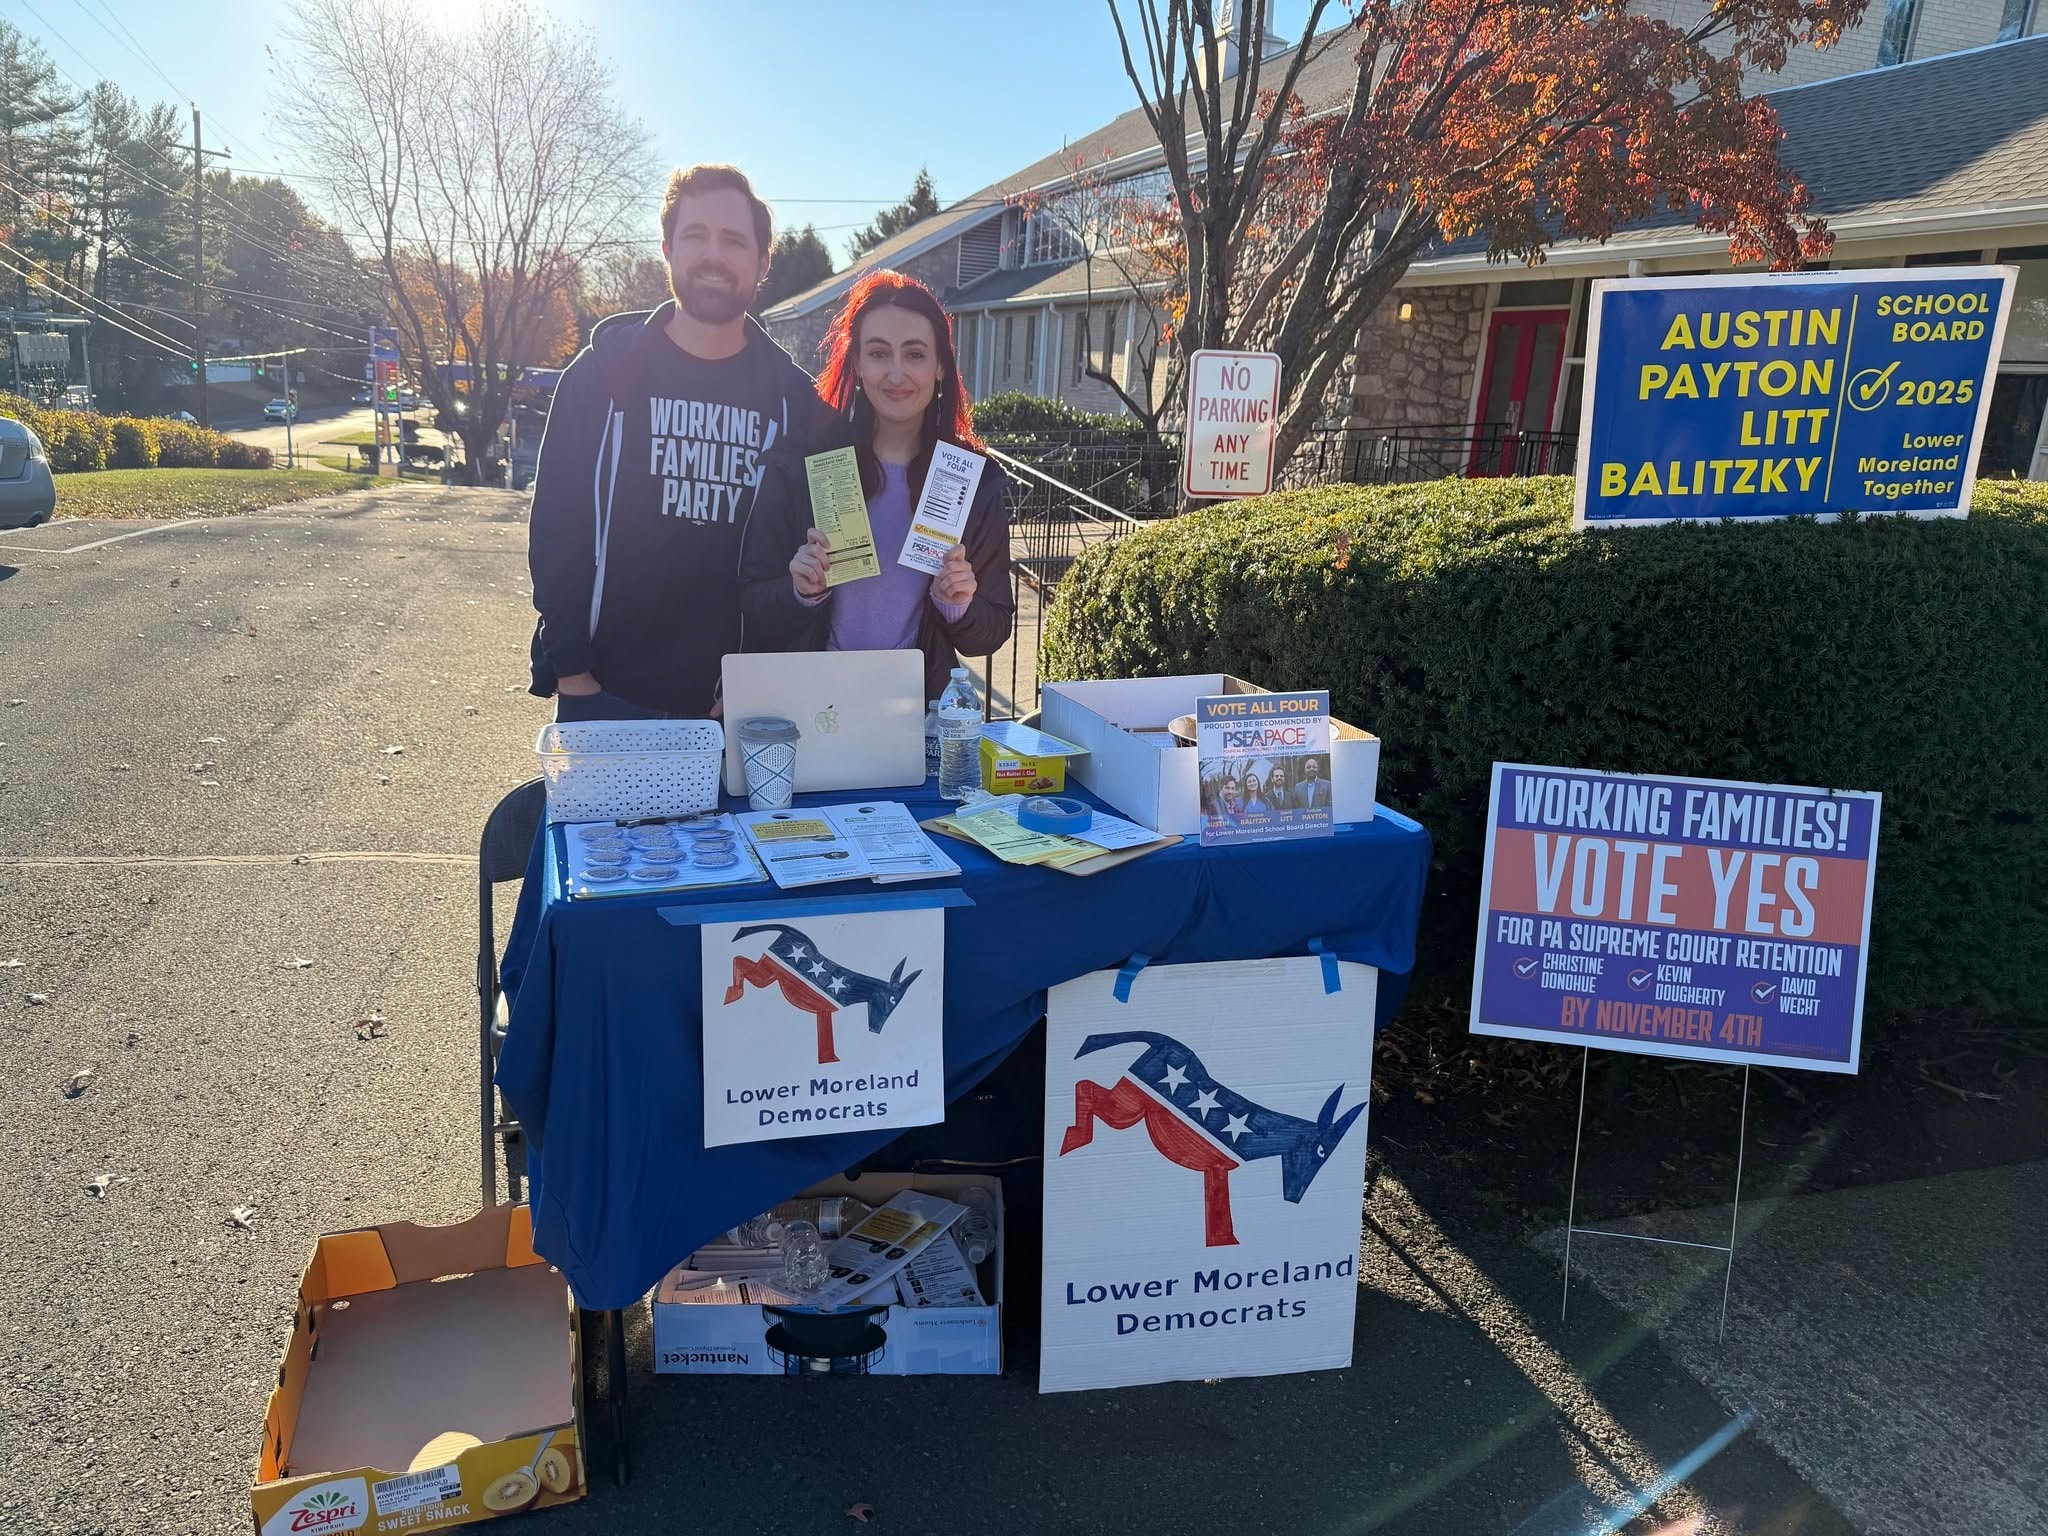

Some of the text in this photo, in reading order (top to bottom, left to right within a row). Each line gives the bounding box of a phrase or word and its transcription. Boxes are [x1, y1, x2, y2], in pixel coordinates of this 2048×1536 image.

[1876, 293, 1990, 317] SCHOOL
[1660, 308, 1842, 351] AUSTIN
[1892, 321, 1985, 343] BOARD
[1220, 365, 1251, 392] NO
[1638, 359, 1835, 401] PAYTON
[1895, 379, 1974, 406] 2025
[650, 397, 761, 449] WORKING
[1198, 397, 1269, 424] PARKING
[1740, 408, 1830, 447] LITT
[1213, 434, 1250, 454] ANY
[1902, 432, 1964, 449] Lower
[649, 437, 759, 488] FAMILIES
[942, 451, 974, 469] VOTE ALL
[946, 461, 967, 473] FOUR
[1210, 461, 1251, 481] TIME
[1857, 454, 1959, 475] Moreland
[1599, 456, 1823, 498] BALITZKY
[661, 478, 743, 524] PARTY
[1863, 479, 1955, 501] Together
[1207, 699, 1319, 717] VOTE ALL FOUR
[1204, 722, 1231, 730] PROUD
[1254, 717, 1311, 727] RECOMMENDED
[1514, 775, 1851, 852] WORKING FAMILIES!
[1215, 829, 1234, 837] Lower
[1235, 827, 1264, 835] Moreland
[1264, 824, 1286, 833] School
[1286, 822, 1304, 831] Board
[1532, 832, 1820, 938] VOTE YES
[1497, 915, 1843, 977] FOR PA SUPREME COURT RETENTION
[1542, 952, 1604, 976] CHRISTINE
[1656, 964, 1692, 985] KEVIN
[1540, 971, 1597, 994] DONOHUE
[1780, 976, 1817, 997] DAVID
[1655, 983, 1726, 1008] DOUGHERTY
[1779, 995, 1821, 1017] WECHT
[1560, 995, 1763, 1048] BY NOVEMBER 4TH
[727, 1069, 920, 1105] Lower Moreland
[758, 1100, 889, 1127] Democrats
[1066, 1254, 1353, 1305] Lower Moreland
[1116, 1297, 1307, 1336] Democrats
[663, 1353, 749, 1366] Nantucket
[289, 1501, 356, 1532] Zespri
[377, 1513, 422, 1532] SWEET
[426, 1503, 471, 1522] SNACK
[401, 1502, 445, 1517] NUTRITIOUS
[310, 1522, 345, 1533] KIWIFRUIT
